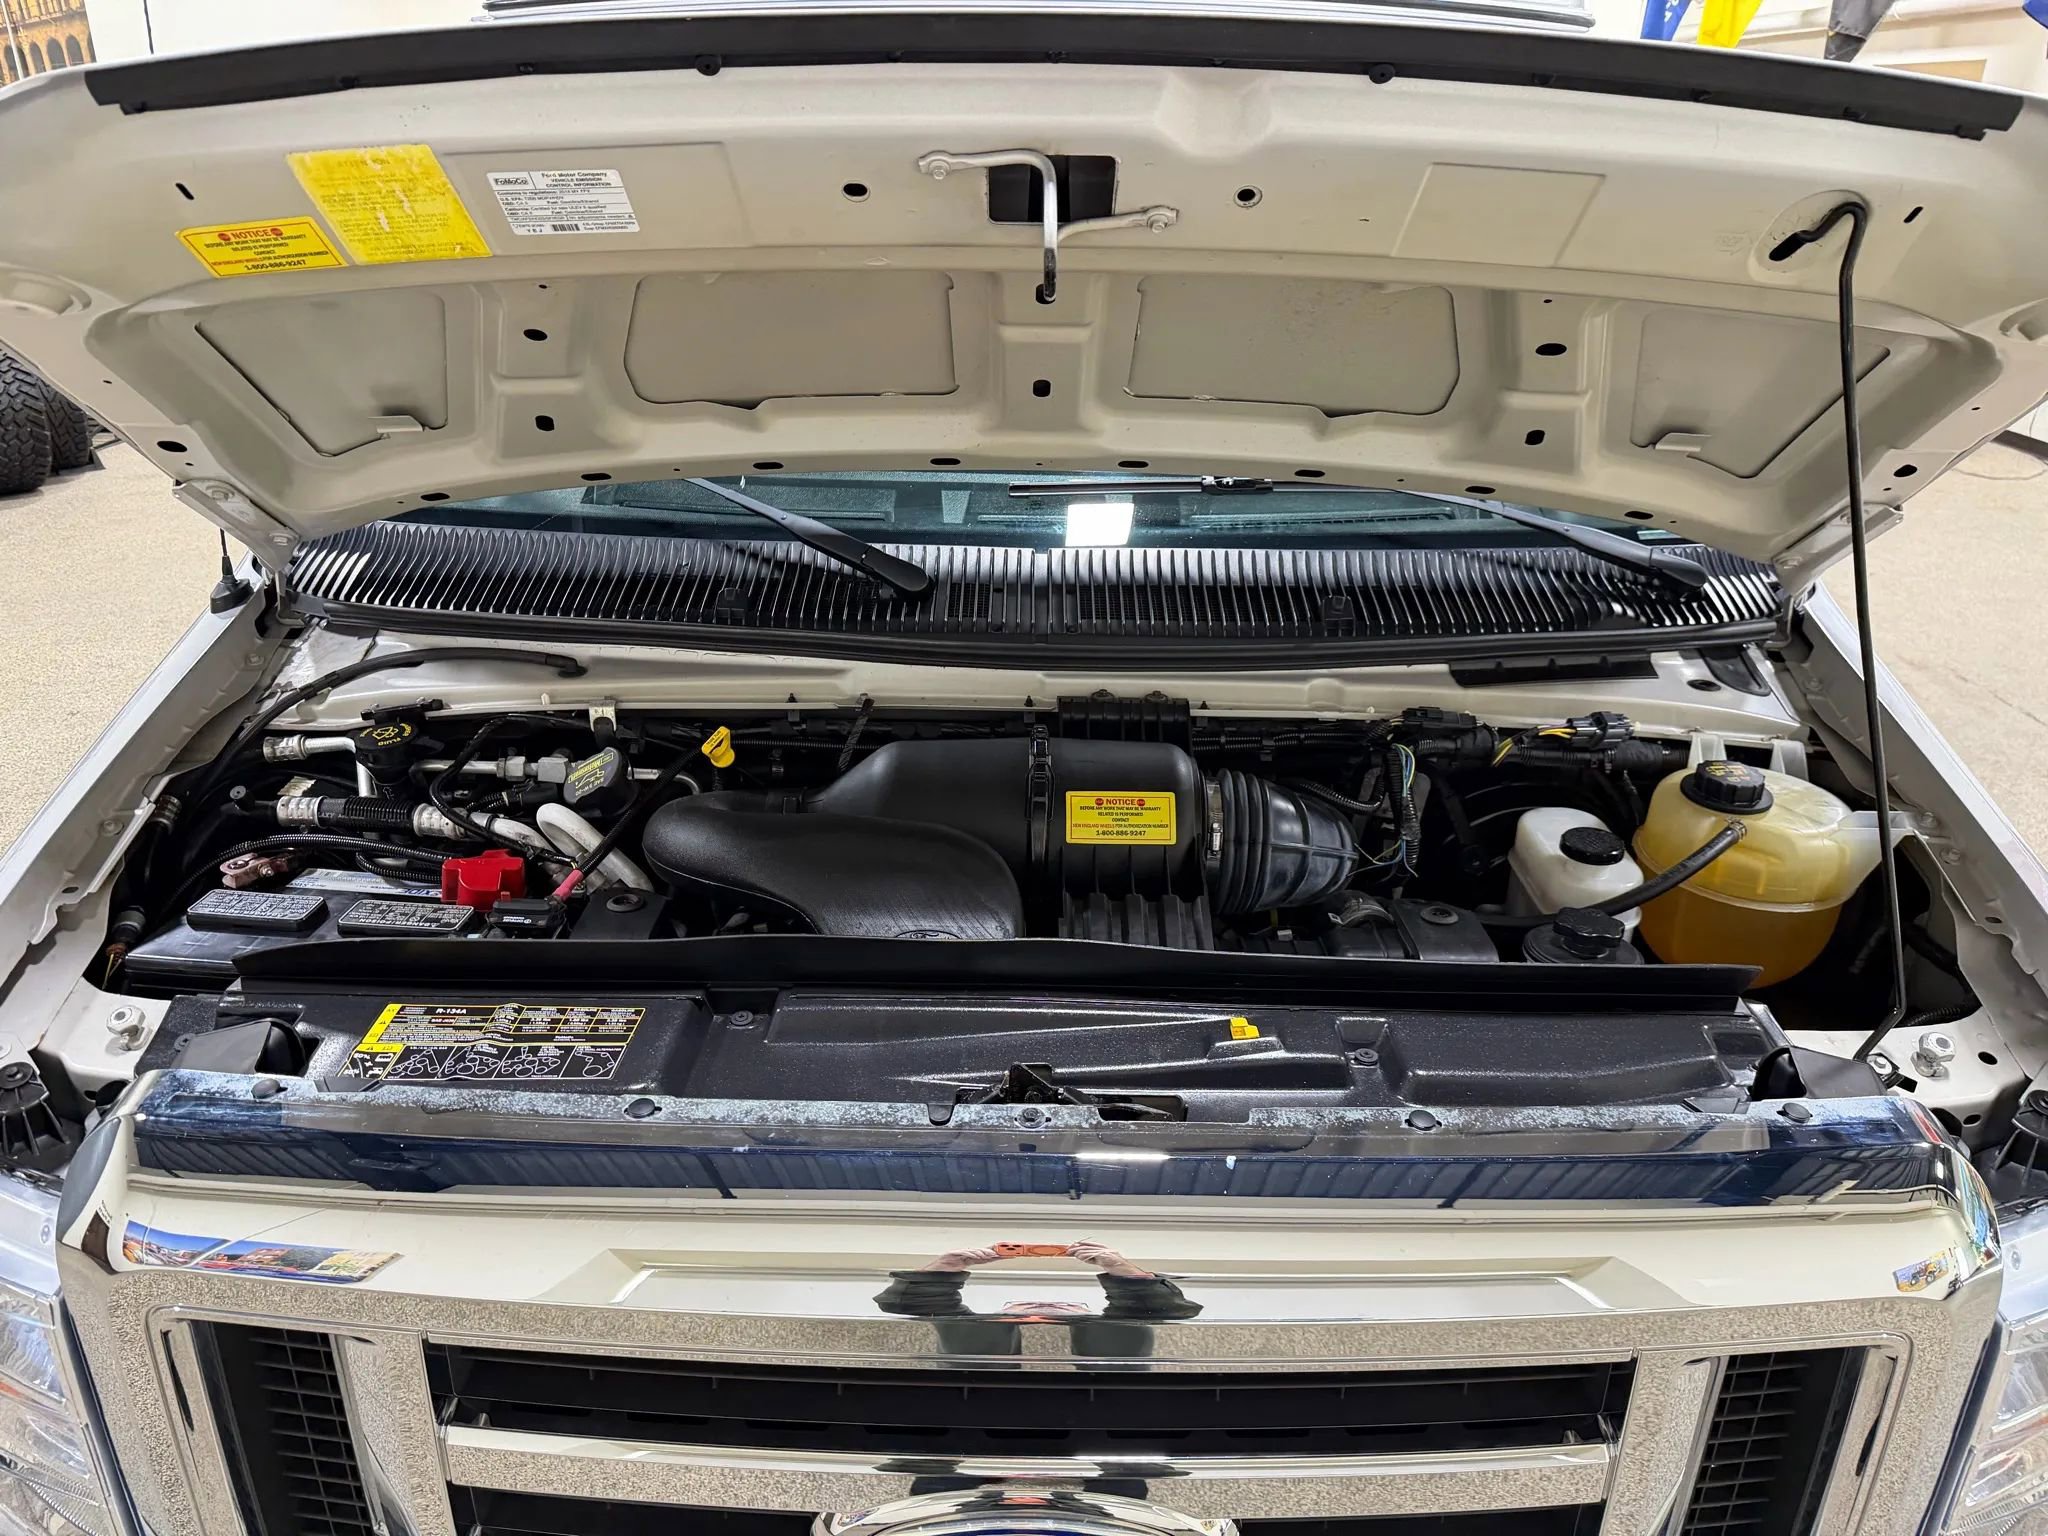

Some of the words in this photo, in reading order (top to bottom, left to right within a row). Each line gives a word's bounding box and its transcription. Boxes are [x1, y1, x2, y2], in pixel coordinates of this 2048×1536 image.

[494, 178, 528, 186] FoMoCo
[231, 229, 272, 240] NOTICE
[1105, 798, 1137, 806] NOTICE
[1095, 829, 1147, 837] 1-800-886-9247
[434, 1007, 467, 1015] R-134A
